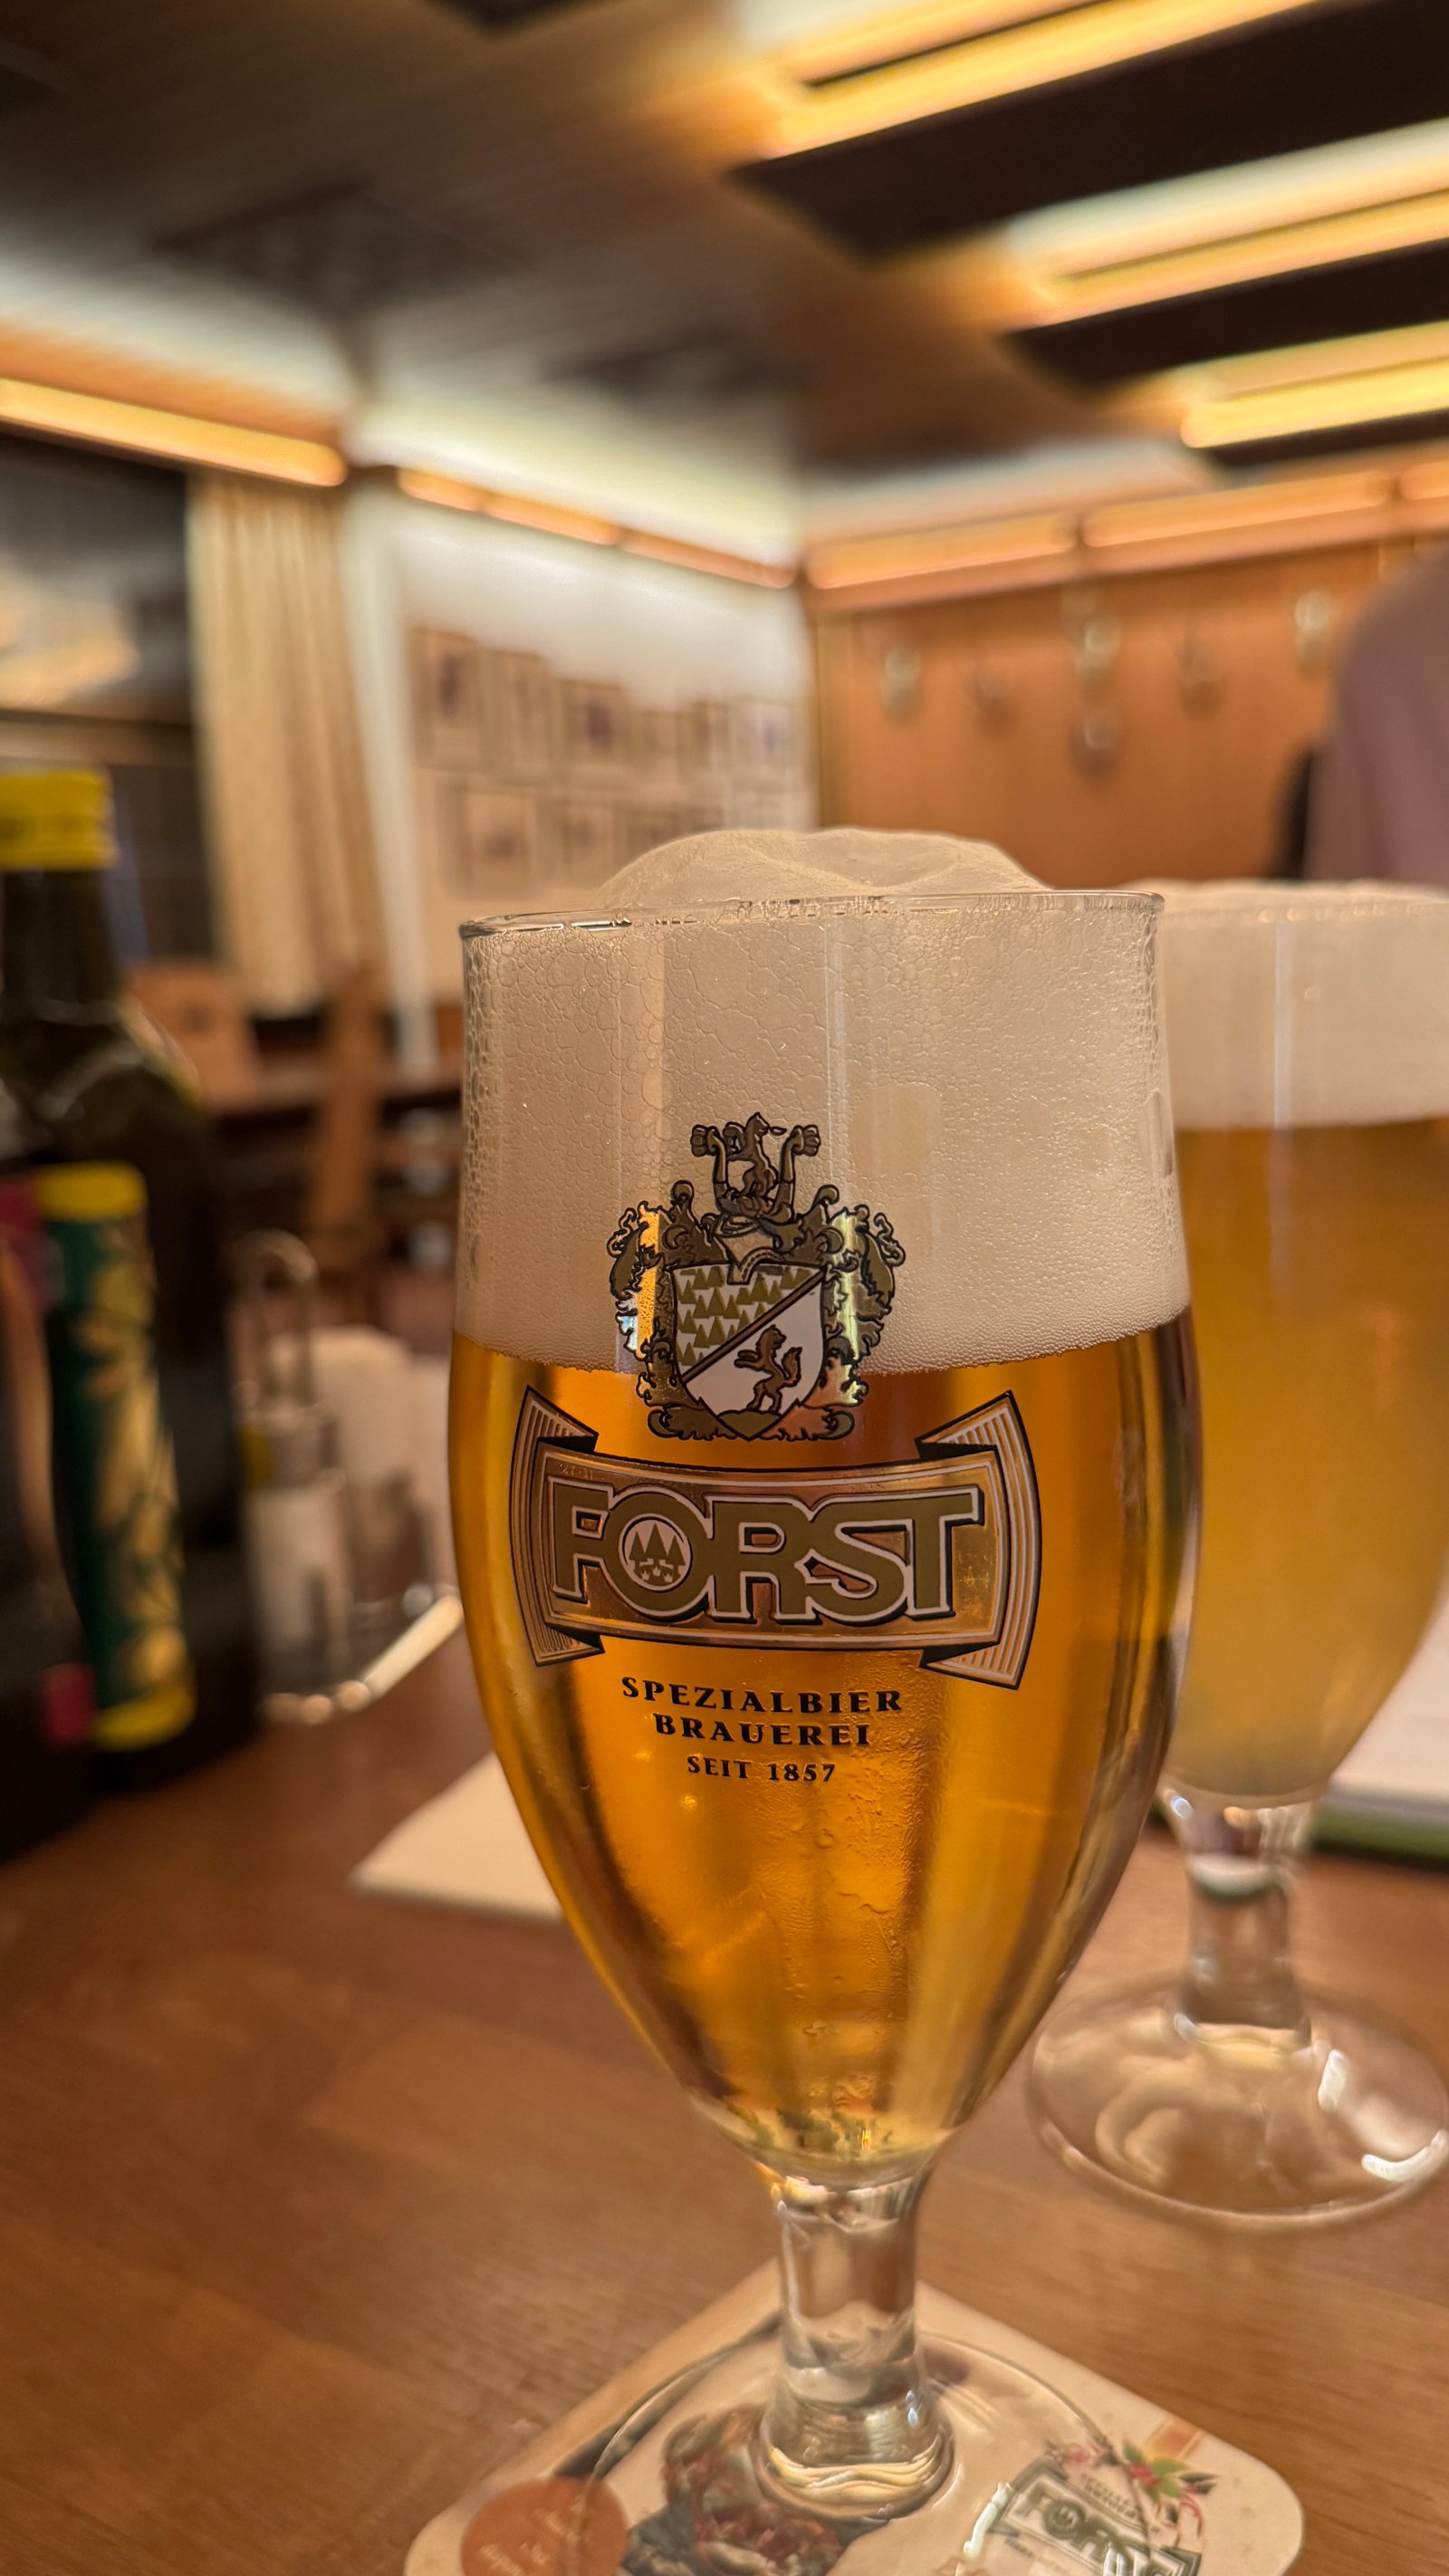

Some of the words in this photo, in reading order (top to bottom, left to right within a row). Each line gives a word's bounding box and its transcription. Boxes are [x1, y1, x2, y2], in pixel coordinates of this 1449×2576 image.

[549, 1477, 984, 1626] FORST
[621, 1677, 902, 1713] SPEZIALBIER
[653, 1713, 870, 1746] BRAUEREI
[687, 1756, 752, 1779] SEIT
[769, 1763, 835, 1783] 1857
